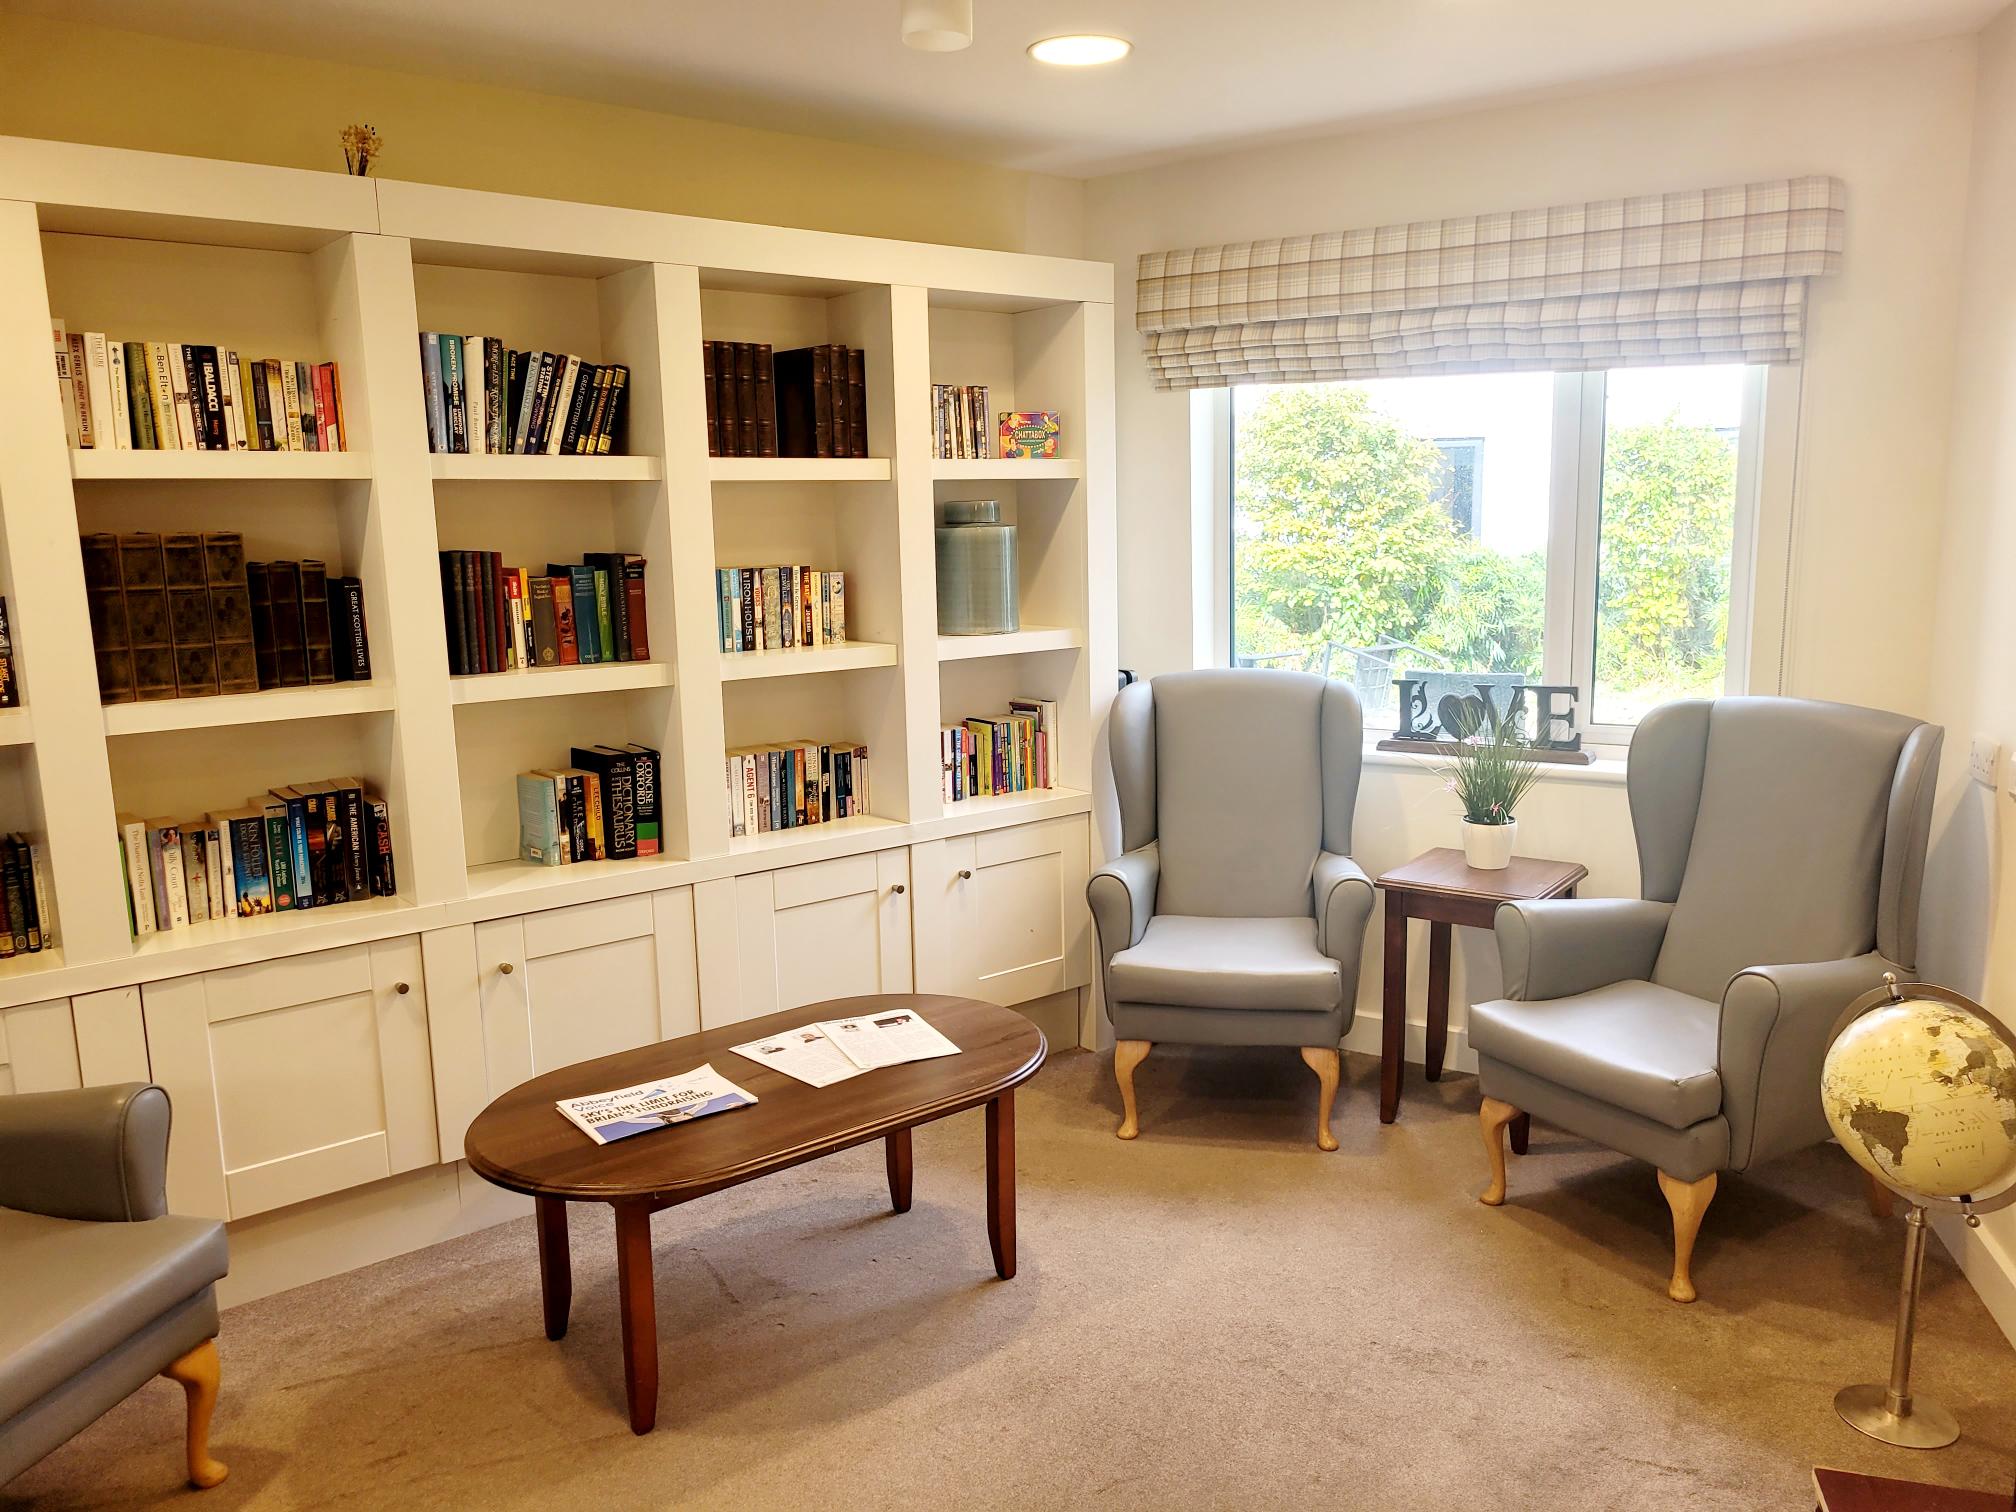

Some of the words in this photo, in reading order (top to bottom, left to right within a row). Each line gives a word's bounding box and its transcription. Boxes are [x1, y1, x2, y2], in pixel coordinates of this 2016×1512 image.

[156, 355, 165, 373] Ben
[204, 366, 219, 412] BALDACCI
[451, 372, 459, 406] PROMISE
[537, 367, 546, 393] STATION
[541, 365, 553, 398] STETTIN
[578, 374, 589, 394] GREAT
[188, 363, 198, 400] ULTRA
[194, 403, 203, 432] SECRET
[571, 395, 584, 426] SCOTTISH
[531, 399, 540, 429] DOWNING
[567, 426, 577, 443] LIVES
[1015, 430, 1046, 439] CHATTABOX
[350, 591, 359, 613] GREAT
[743, 580, 751, 604] IRON
[353, 614, 362, 647] SCOTTISH
[356, 648, 365, 667] LIVES
[636, 762, 646, 804] OXFORD
[645, 762, 654, 804] CONCISE
[745, 767, 754, 791] AGENT
[611, 781, 626, 848] THESAURUS
[621, 776, 635, 848] DICTIONARY
[247, 822, 259, 842] KEN
[350, 817, 359, 851] AMERICAN
[377, 822, 390, 855] CASH
[572, 1090, 644, 1108] Abbeyfield
[574, 1102, 614, 1112] Voice
[580, 1107, 613, 1118] SKY'S
[616, 1104, 636, 1113] THE
[640, 1096, 670, 1107] LIMIT
[672, 1090, 694, 1100] FOR
[586, 1110, 634, 1124] BRIAN'S
[637, 1090, 714, 1113] FUNDRAISING
